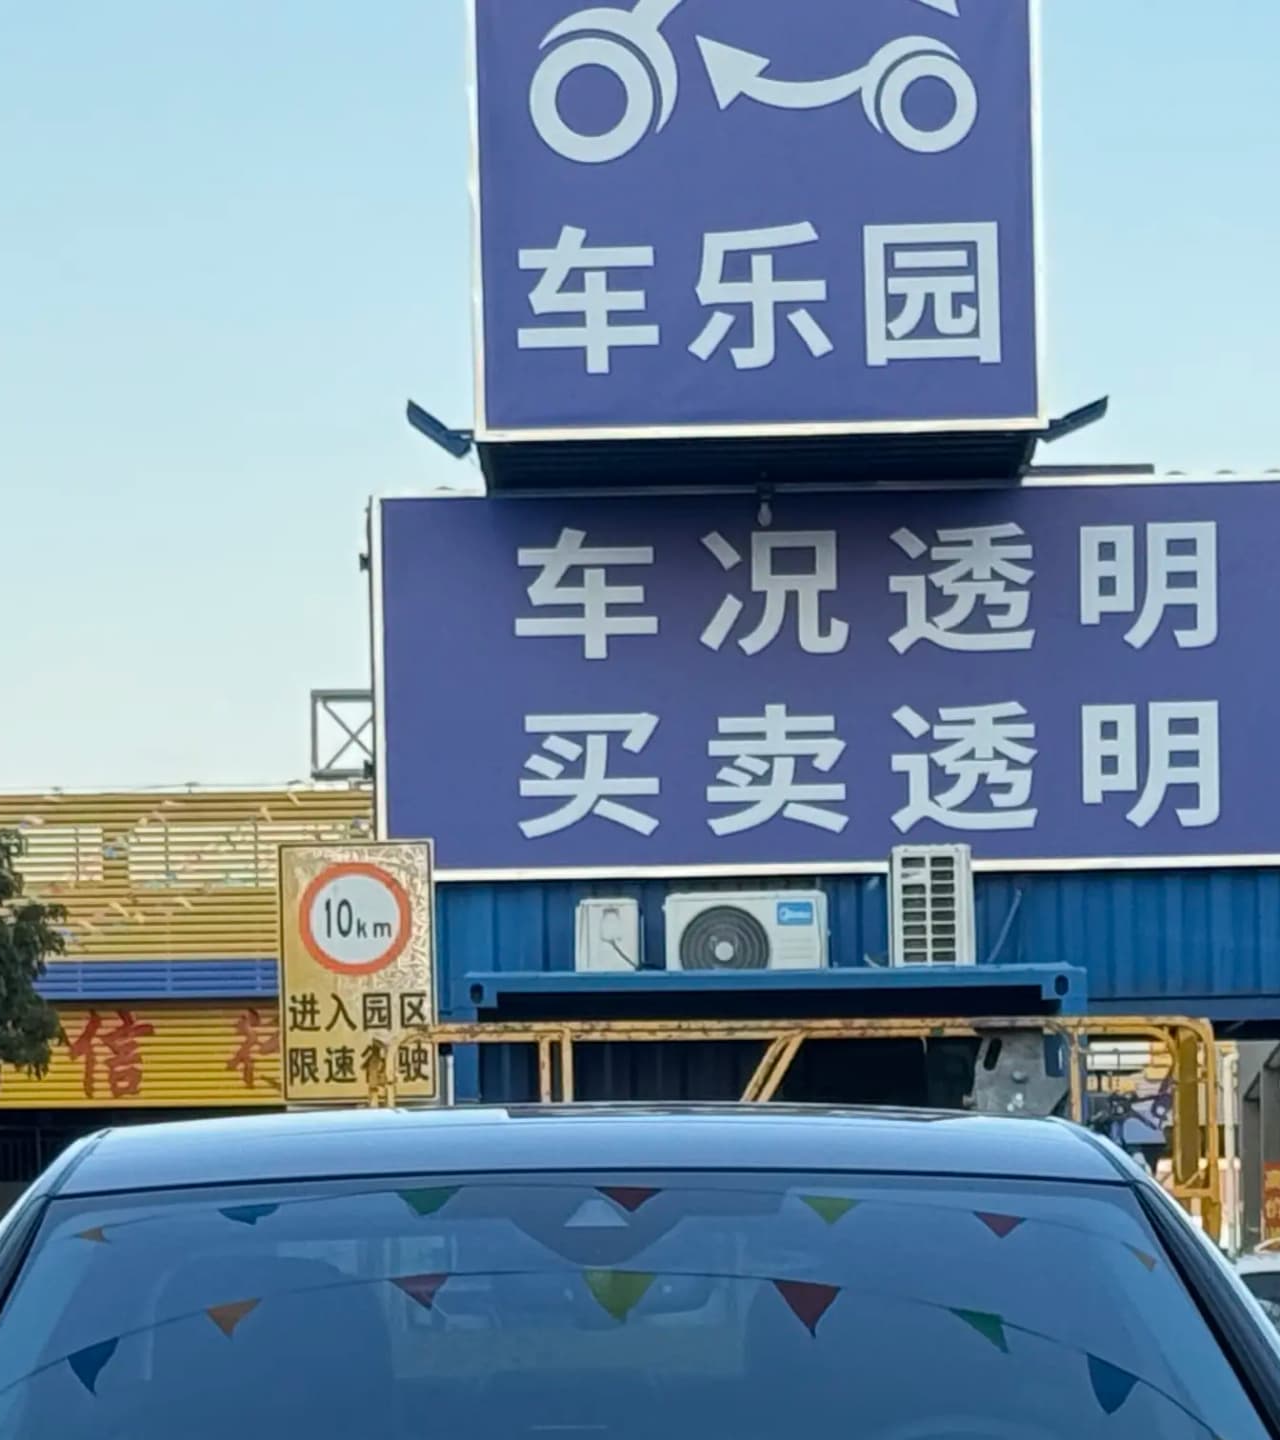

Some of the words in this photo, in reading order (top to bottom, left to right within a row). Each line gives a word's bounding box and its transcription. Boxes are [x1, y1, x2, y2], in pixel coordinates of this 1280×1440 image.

[517, 220, 1002, 374] 车乐园
[515, 519, 1220, 661] 车况透明
[519, 700, 1222, 840] 买卖透明
[324, 898, 392, 939] 10km
[288, 992, 428, 1033] 进入园区
